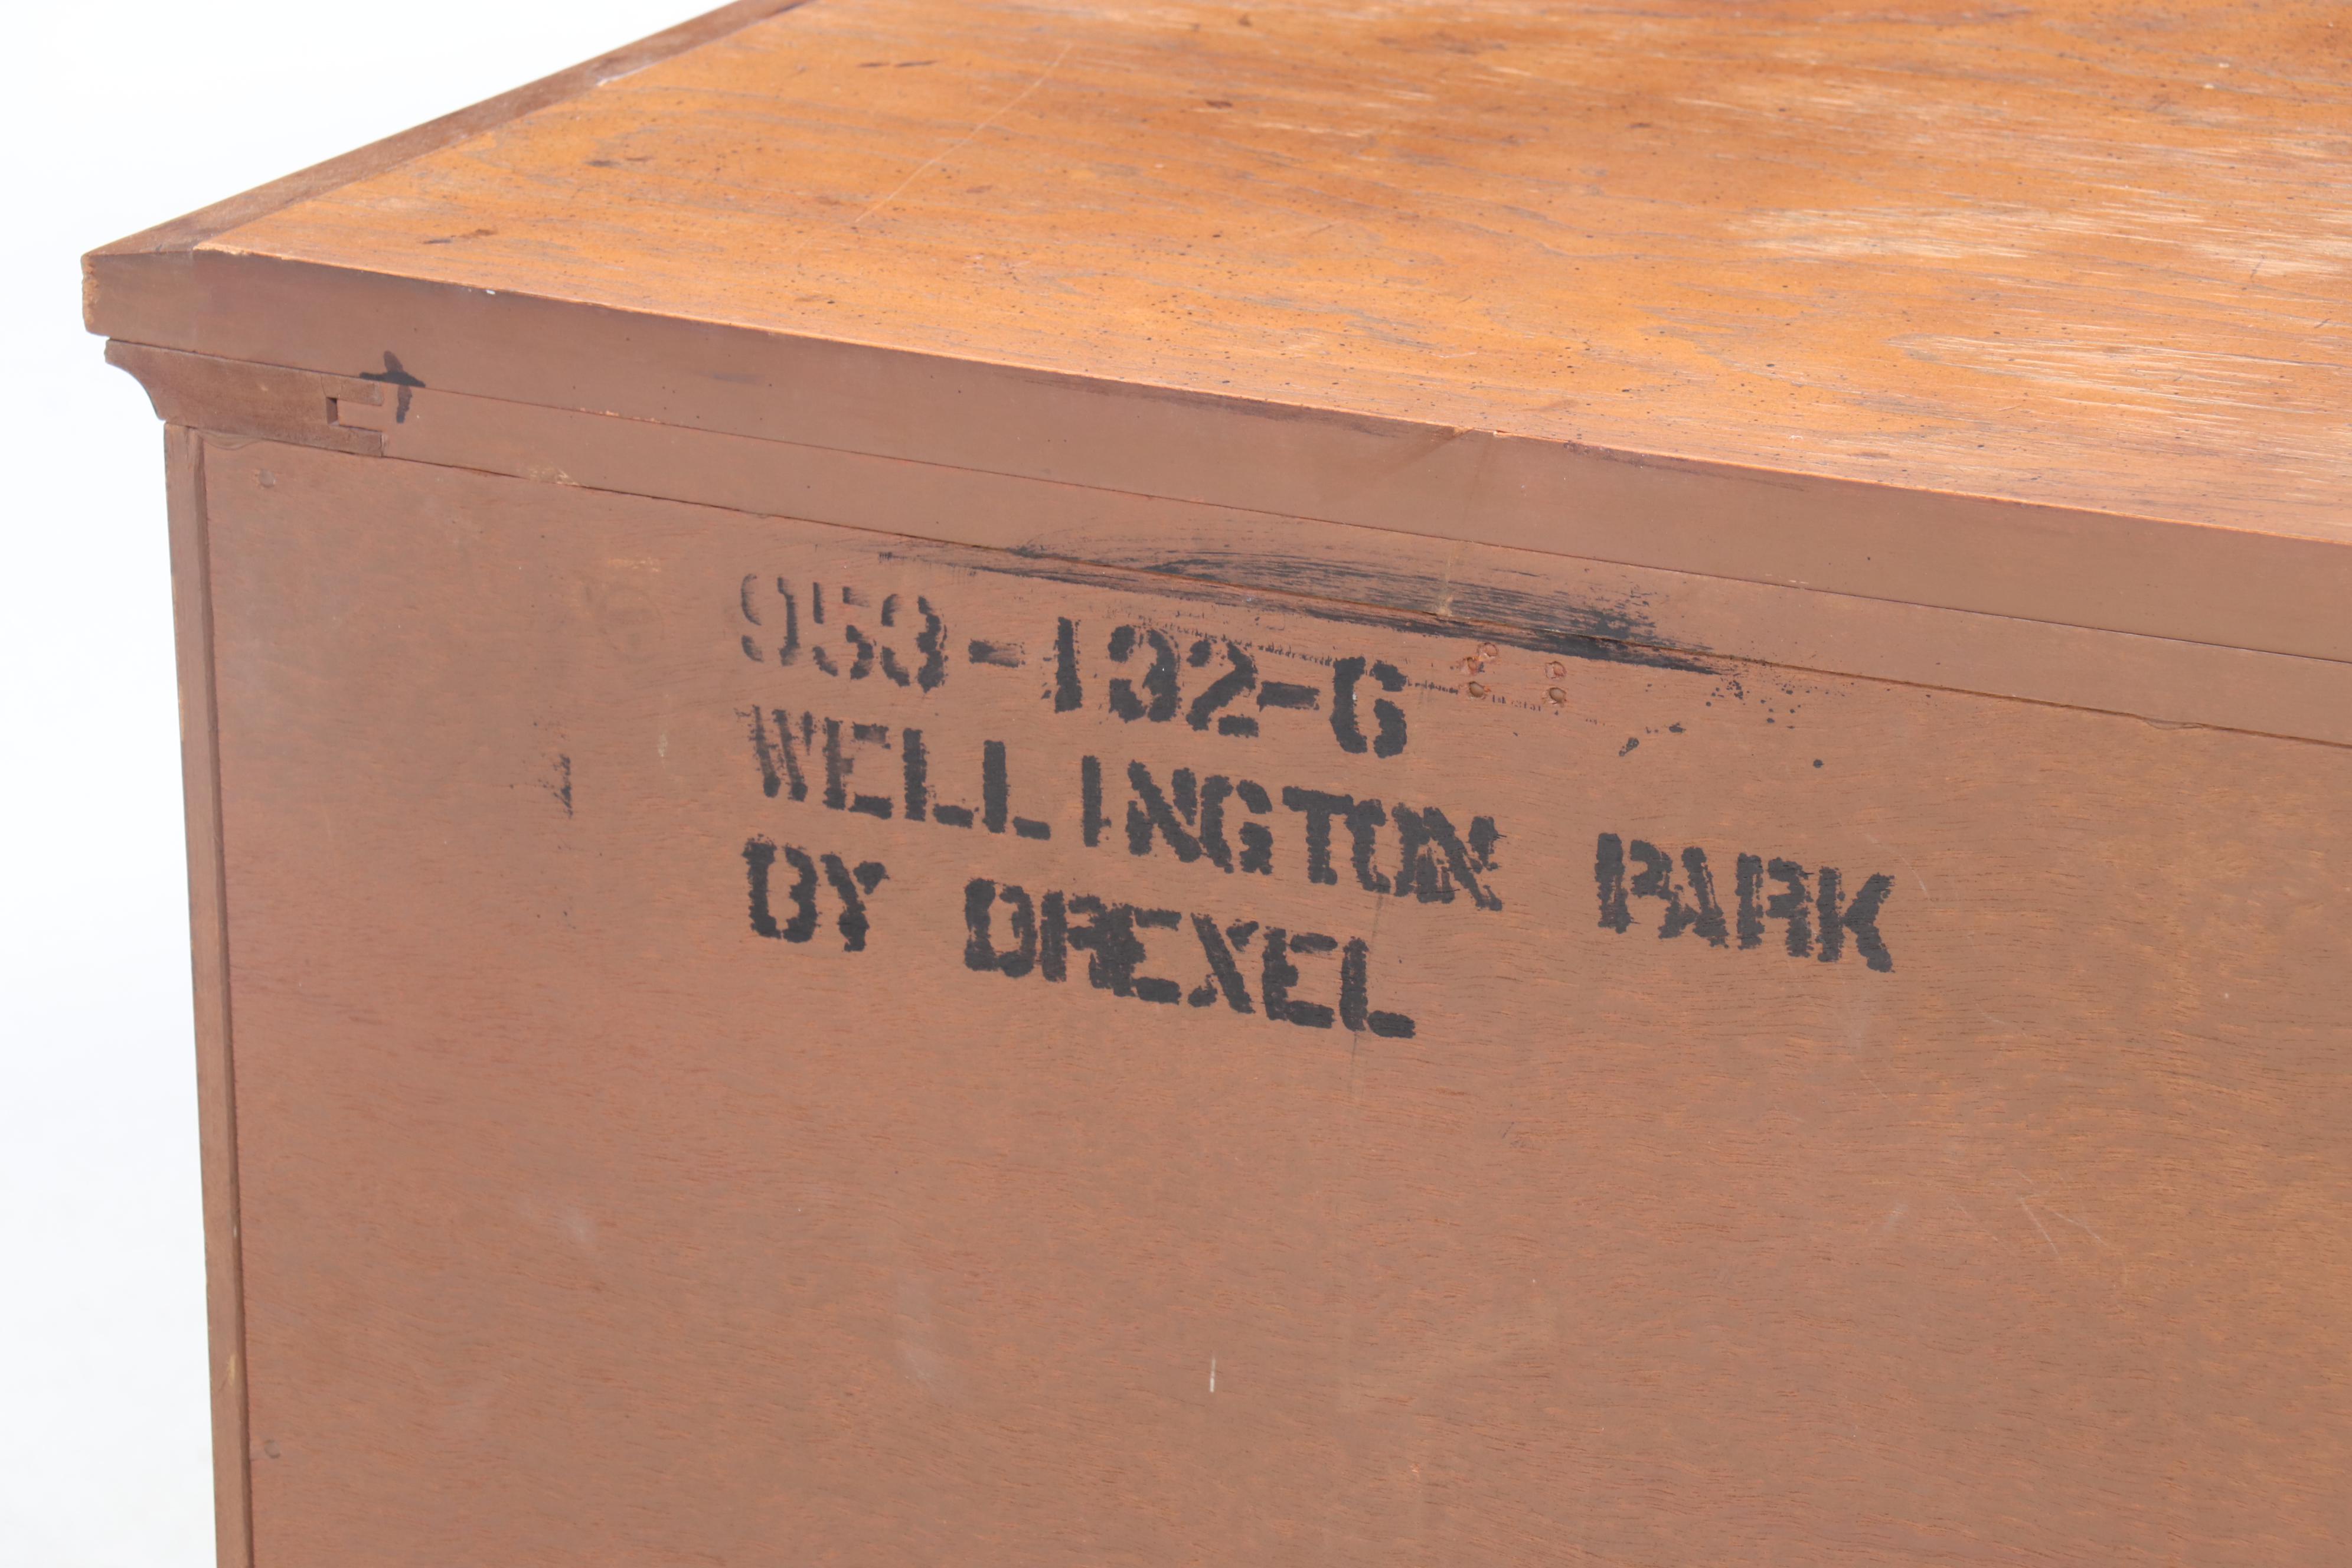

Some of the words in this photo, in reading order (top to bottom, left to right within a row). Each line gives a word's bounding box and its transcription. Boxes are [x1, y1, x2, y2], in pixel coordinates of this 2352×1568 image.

[743, 838, 890, 952] BY
[963, 877, 1417, 1039] DREXEL
[745, 704, 1507, 912] WELLINGTON
[1595, 832, 1894, 974] PARK
